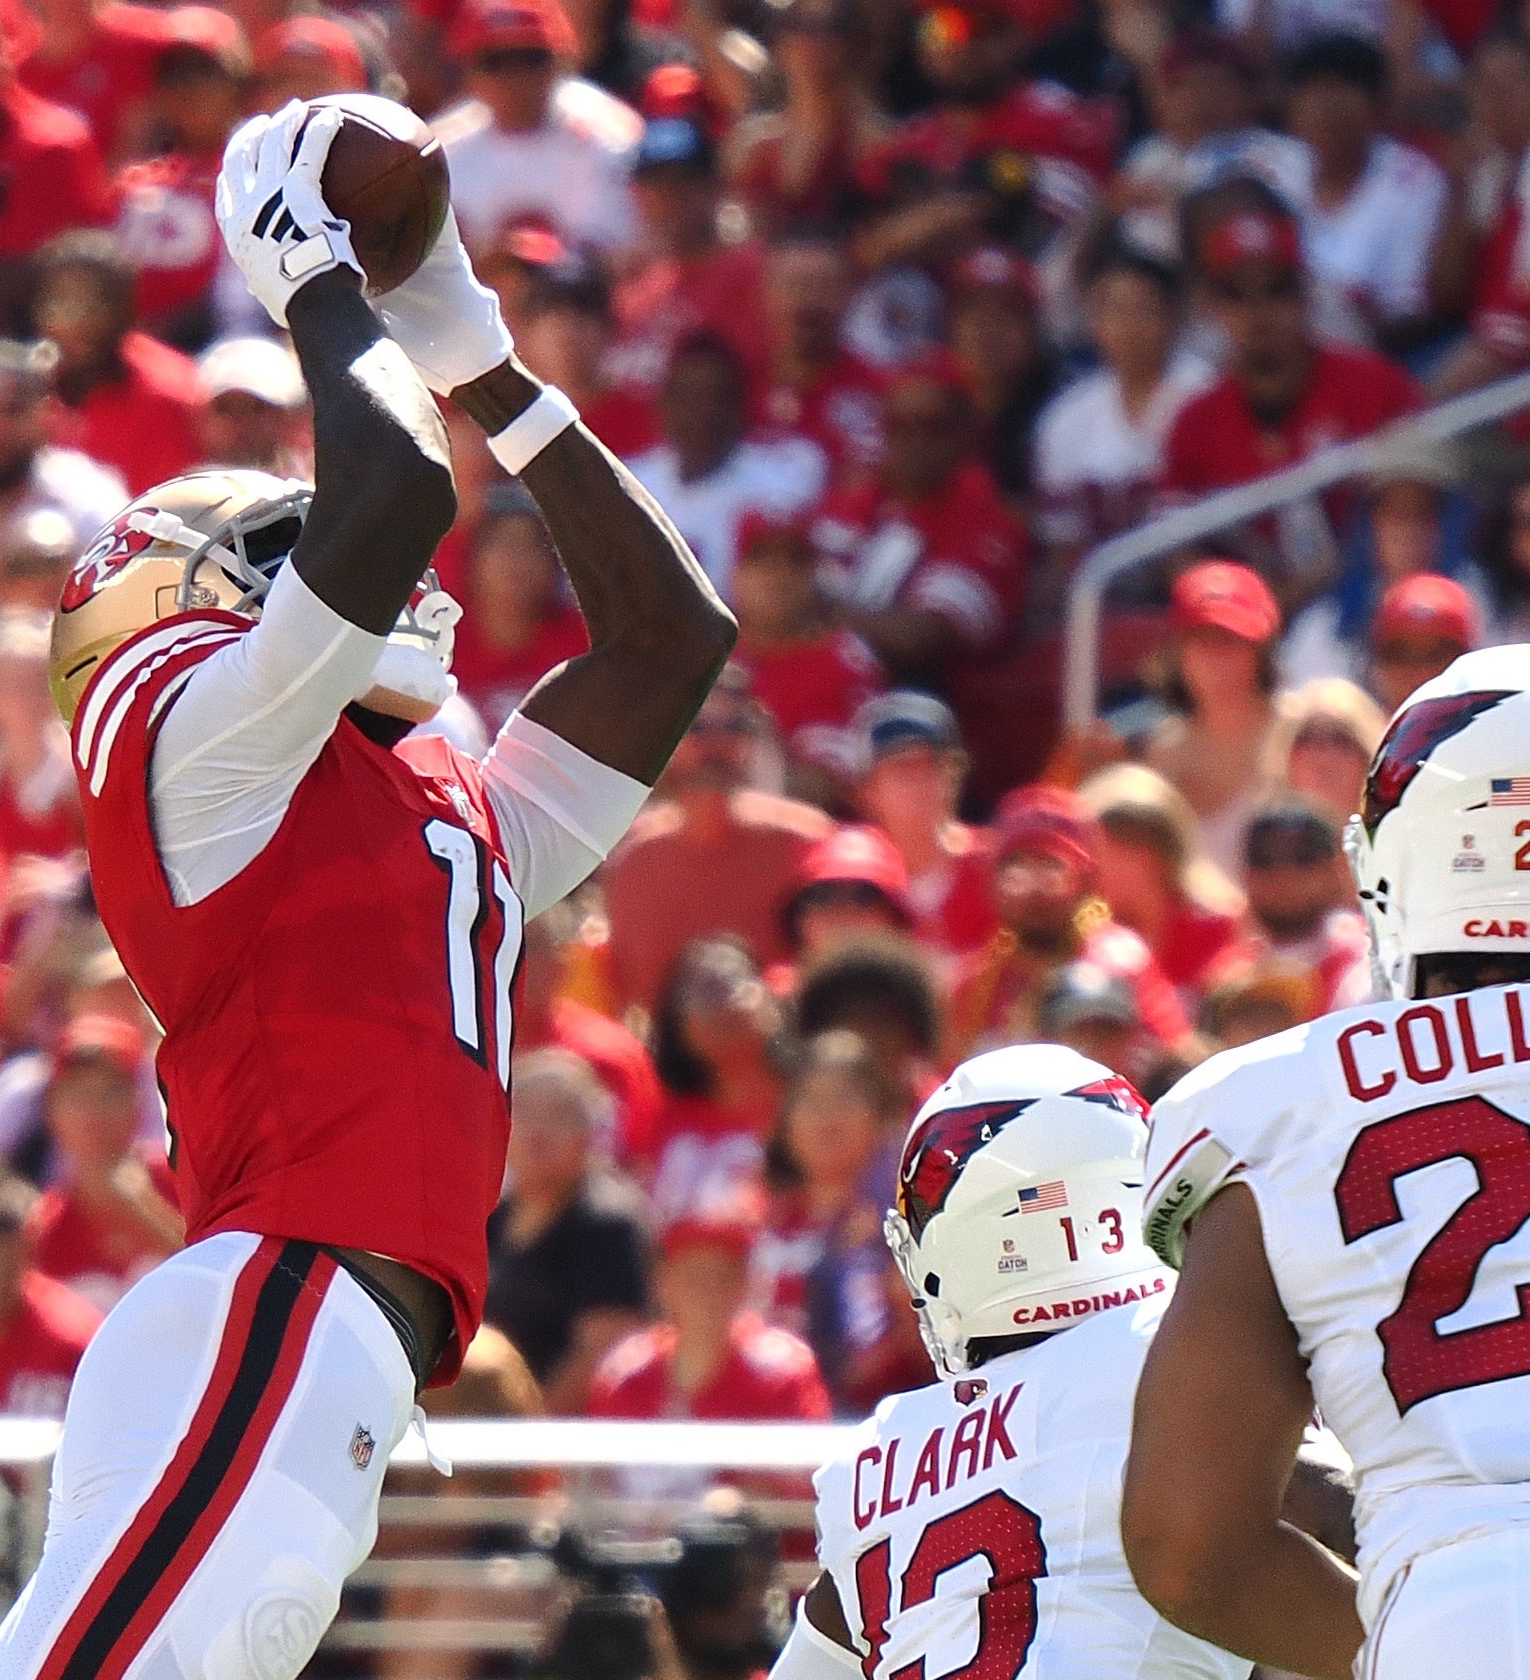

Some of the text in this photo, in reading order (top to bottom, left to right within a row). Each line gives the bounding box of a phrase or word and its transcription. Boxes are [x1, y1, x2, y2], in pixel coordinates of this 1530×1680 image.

[425, 816, 526, 1096] 11
[1012, 1277, 1167, 1325] CARDINALS
[852, 1380, 1027, 1532] CLARK
